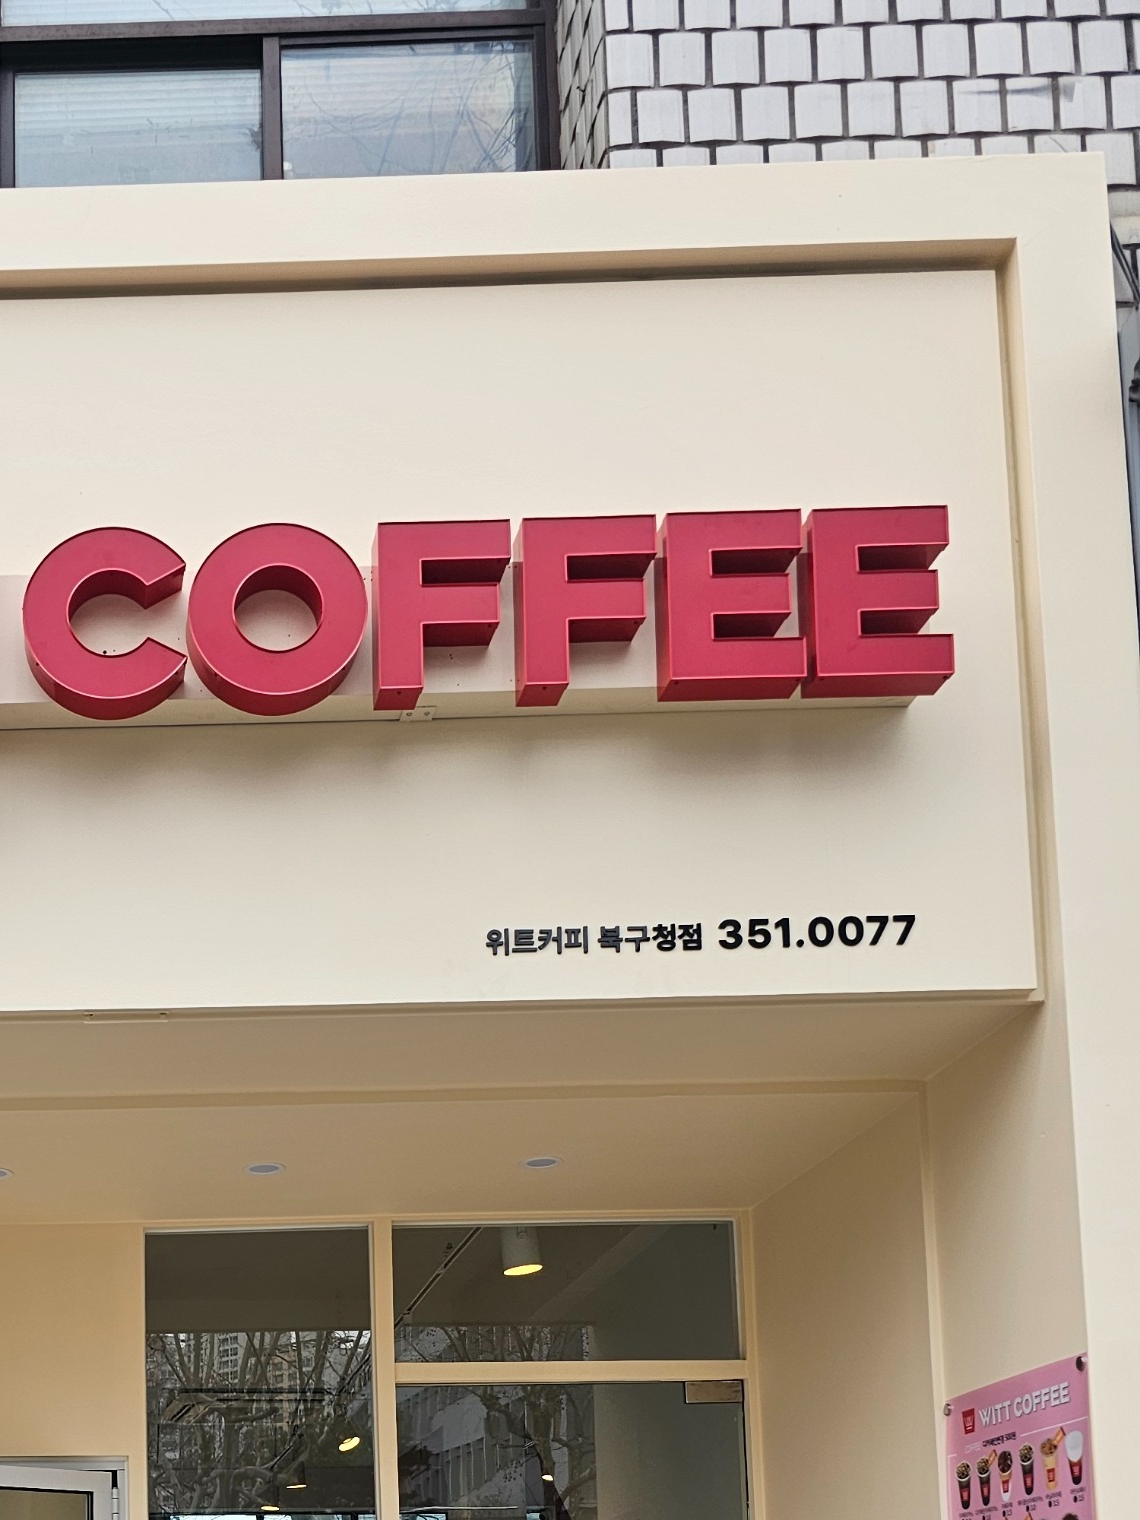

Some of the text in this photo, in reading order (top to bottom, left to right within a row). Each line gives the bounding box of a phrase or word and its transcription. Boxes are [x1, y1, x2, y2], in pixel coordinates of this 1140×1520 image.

[23, 505, 955, 719] COFFEE
[485, 914, 917, 955] 위트커피 북구청점 351.0077
[978, 1381, 1071, 1427] WITT COFFEE
